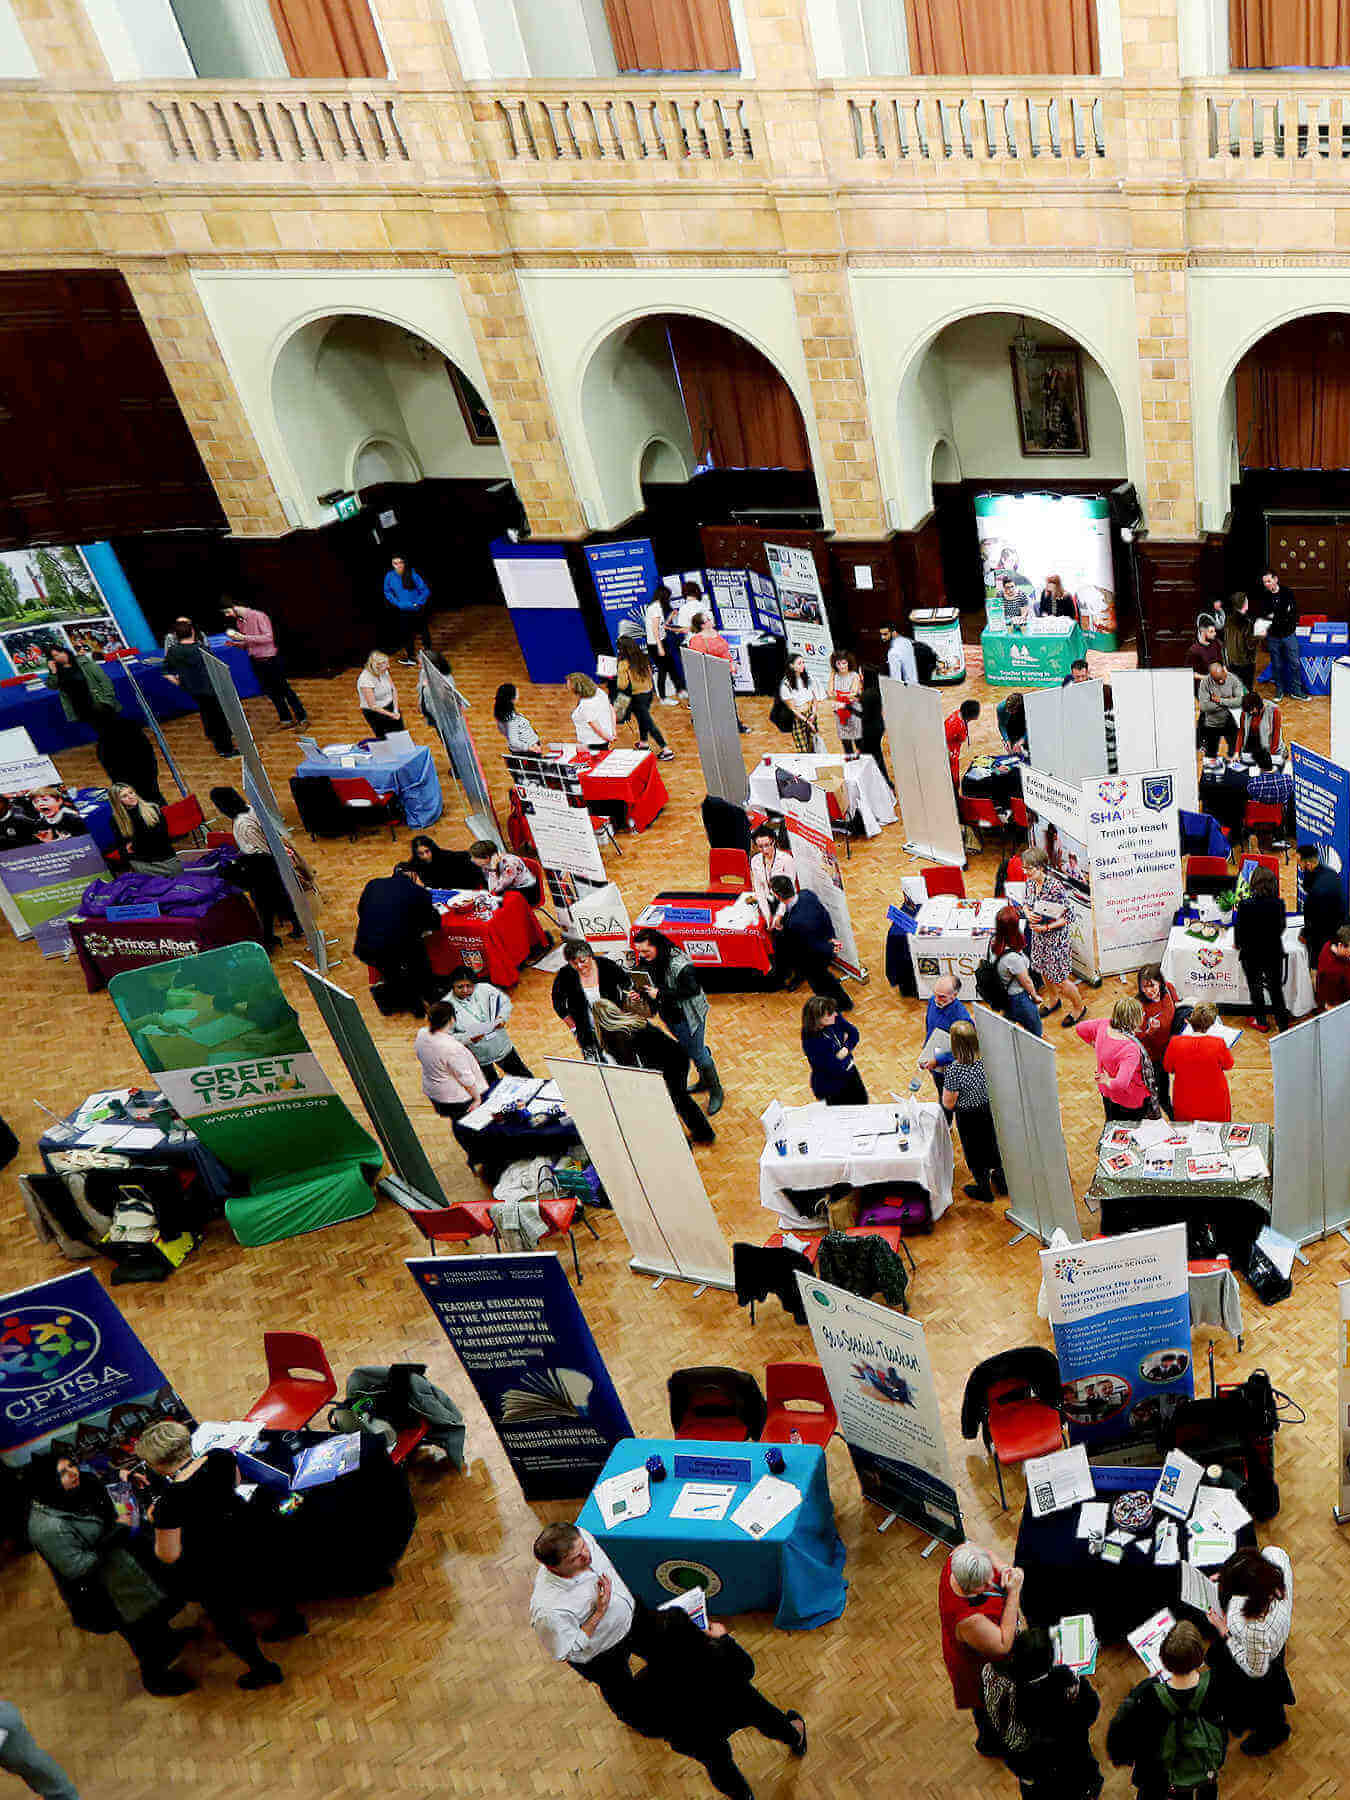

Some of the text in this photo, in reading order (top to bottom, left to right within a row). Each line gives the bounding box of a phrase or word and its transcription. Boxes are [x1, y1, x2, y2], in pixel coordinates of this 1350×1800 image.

[1099, 821, 1169, 841] Train to teach
[1099, 867, 1135, 881] School
[578, 914, 626, 933] RSA
[113, 937, 200, 952] Prince Albert
[1190, 970, 1233, 983] SHAPE
[190, 1058, 295, 1087] GREET
[193, 1080, 264, 1105] TSA
[1060, 1274, 1162, 1302] Improving the talent
[437, 1298, 544, 1312] TEACHER EDUCATION
[1061, 1298, 1081, 1308] and
[1083, 1288, 1129, 1305] potential
[459, 1314, 481, 1323] THE
[481, 1310, 541, 1322] UNIVERSITY
[465, 1322, 537, 1336] BIRMINGHAM
[5, 1365, 129, 1420] CPTSA
